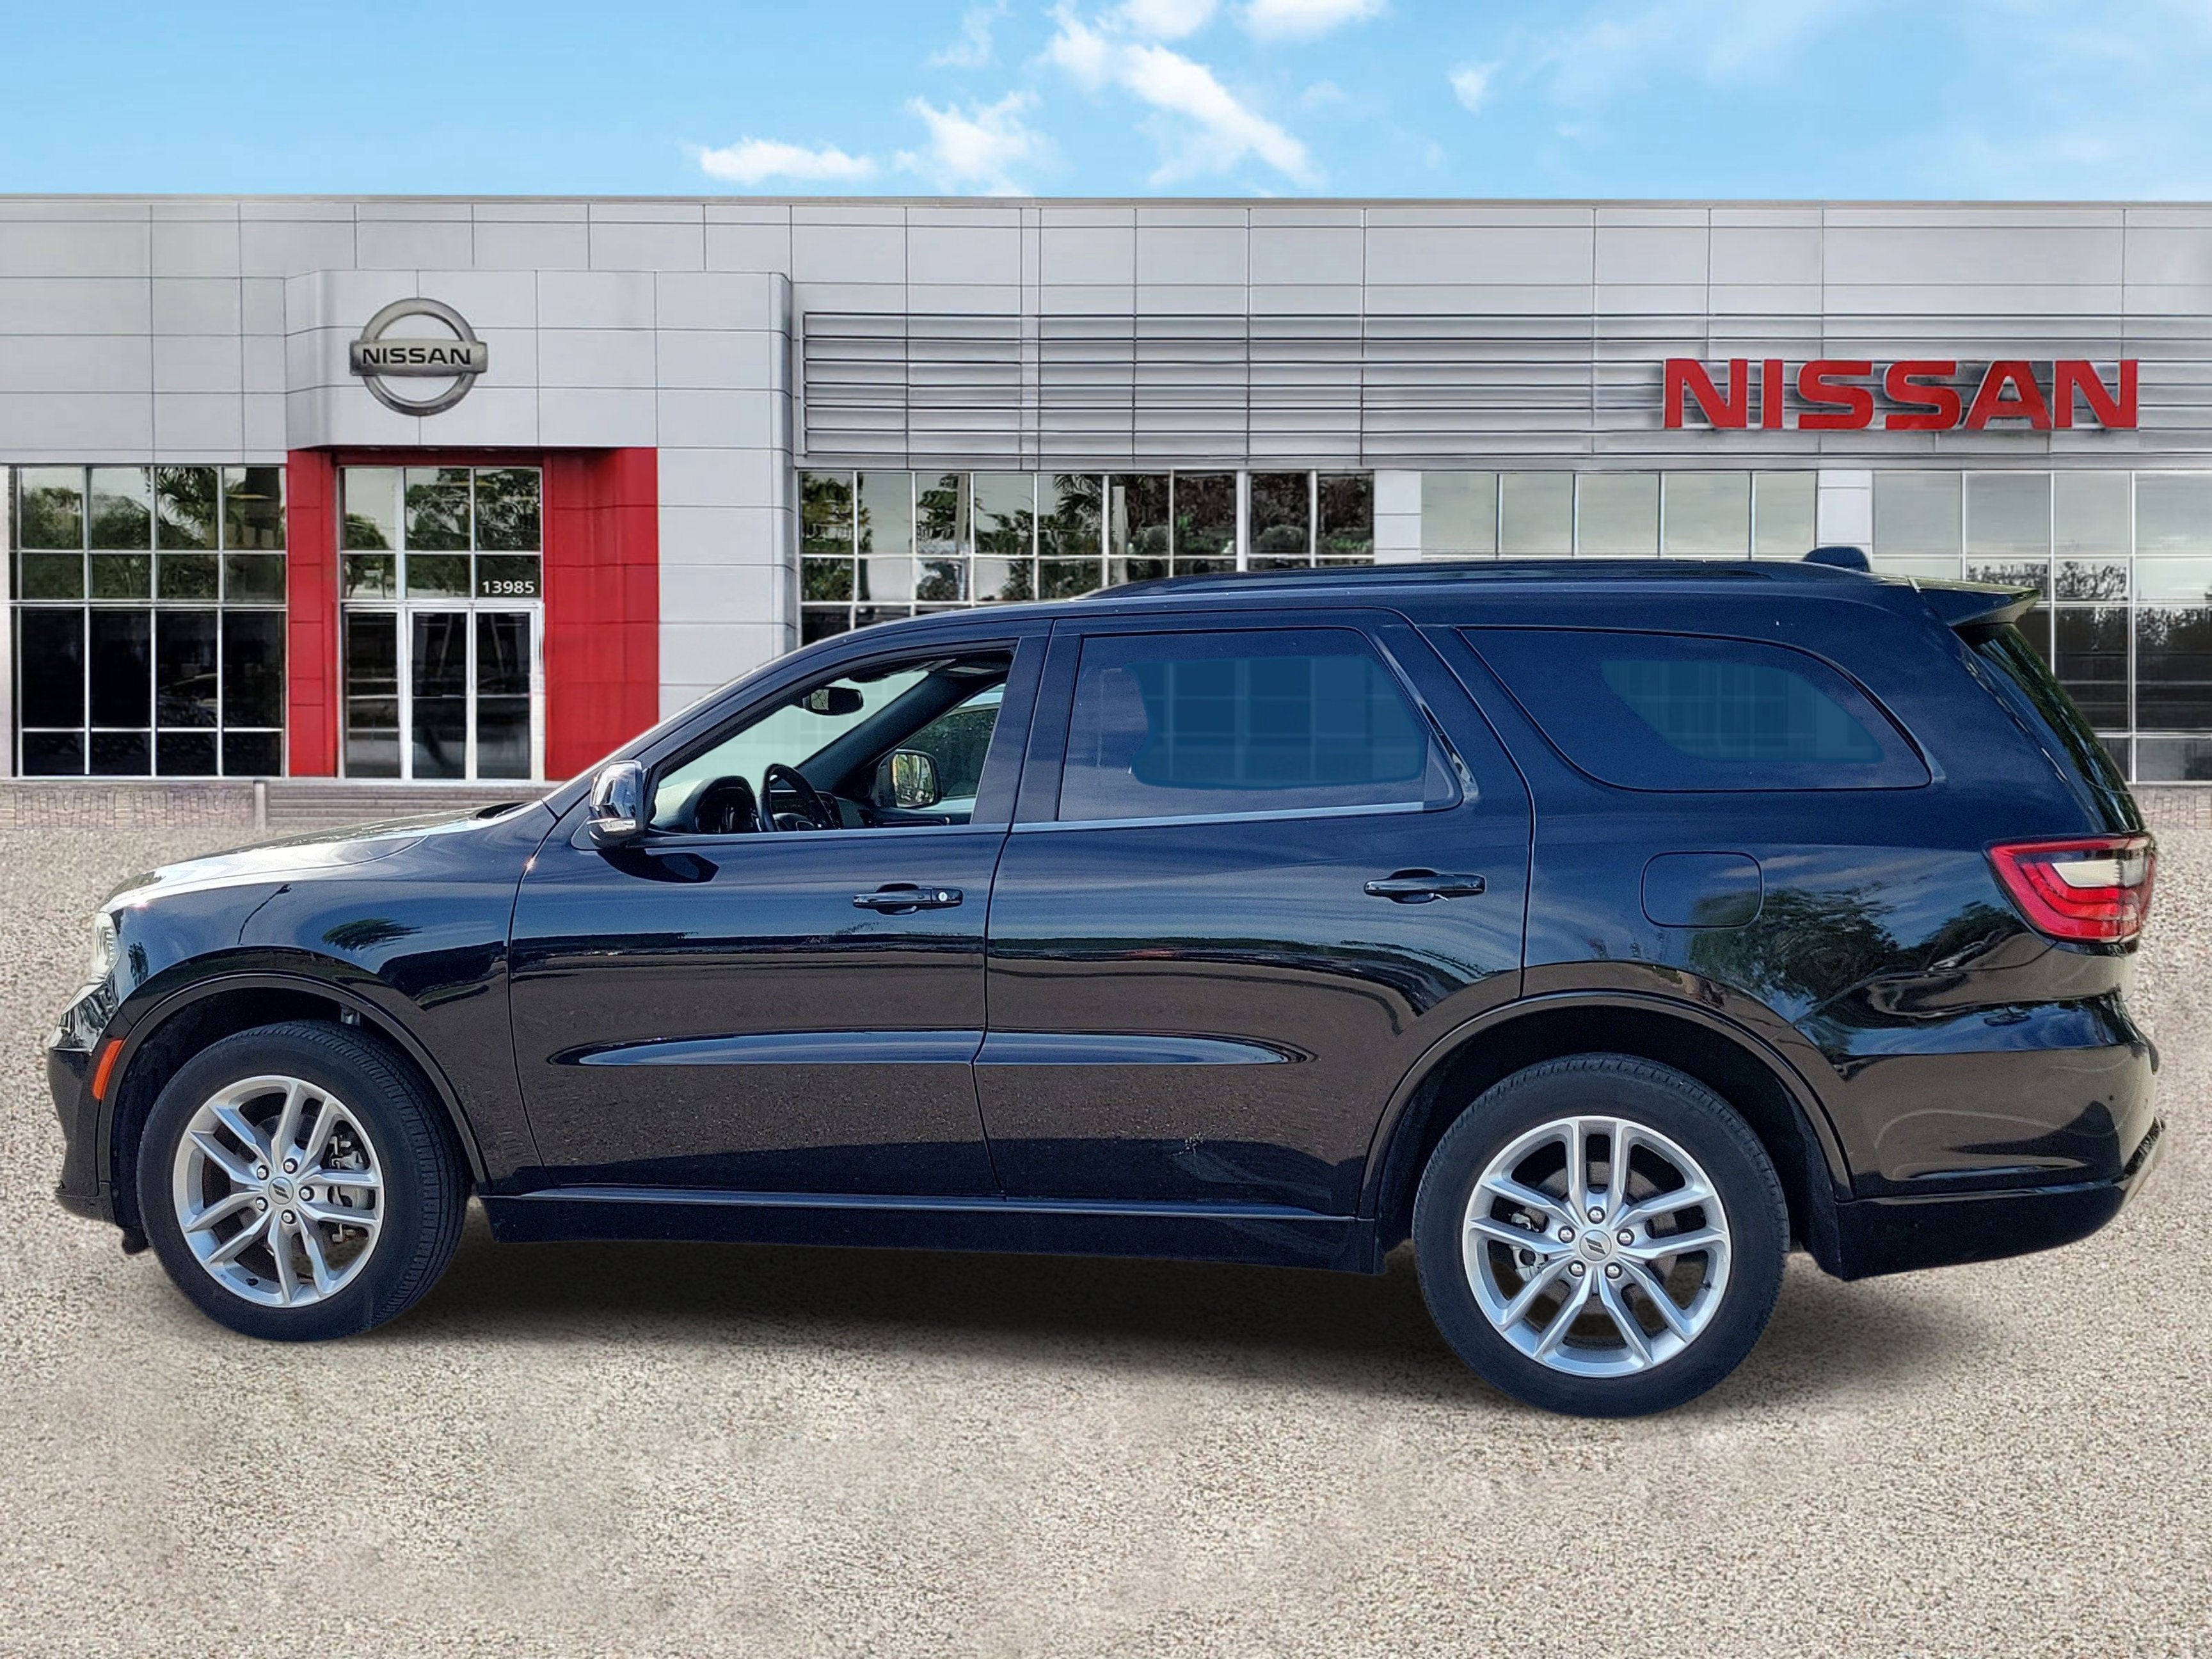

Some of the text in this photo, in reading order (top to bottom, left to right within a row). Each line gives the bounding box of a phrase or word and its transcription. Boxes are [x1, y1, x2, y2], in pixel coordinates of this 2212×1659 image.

[362, 347, 471, 365] NISSAN
[1664, 358, 2139, 429] NISSAN
[482, 581, 535, 594] 13985
